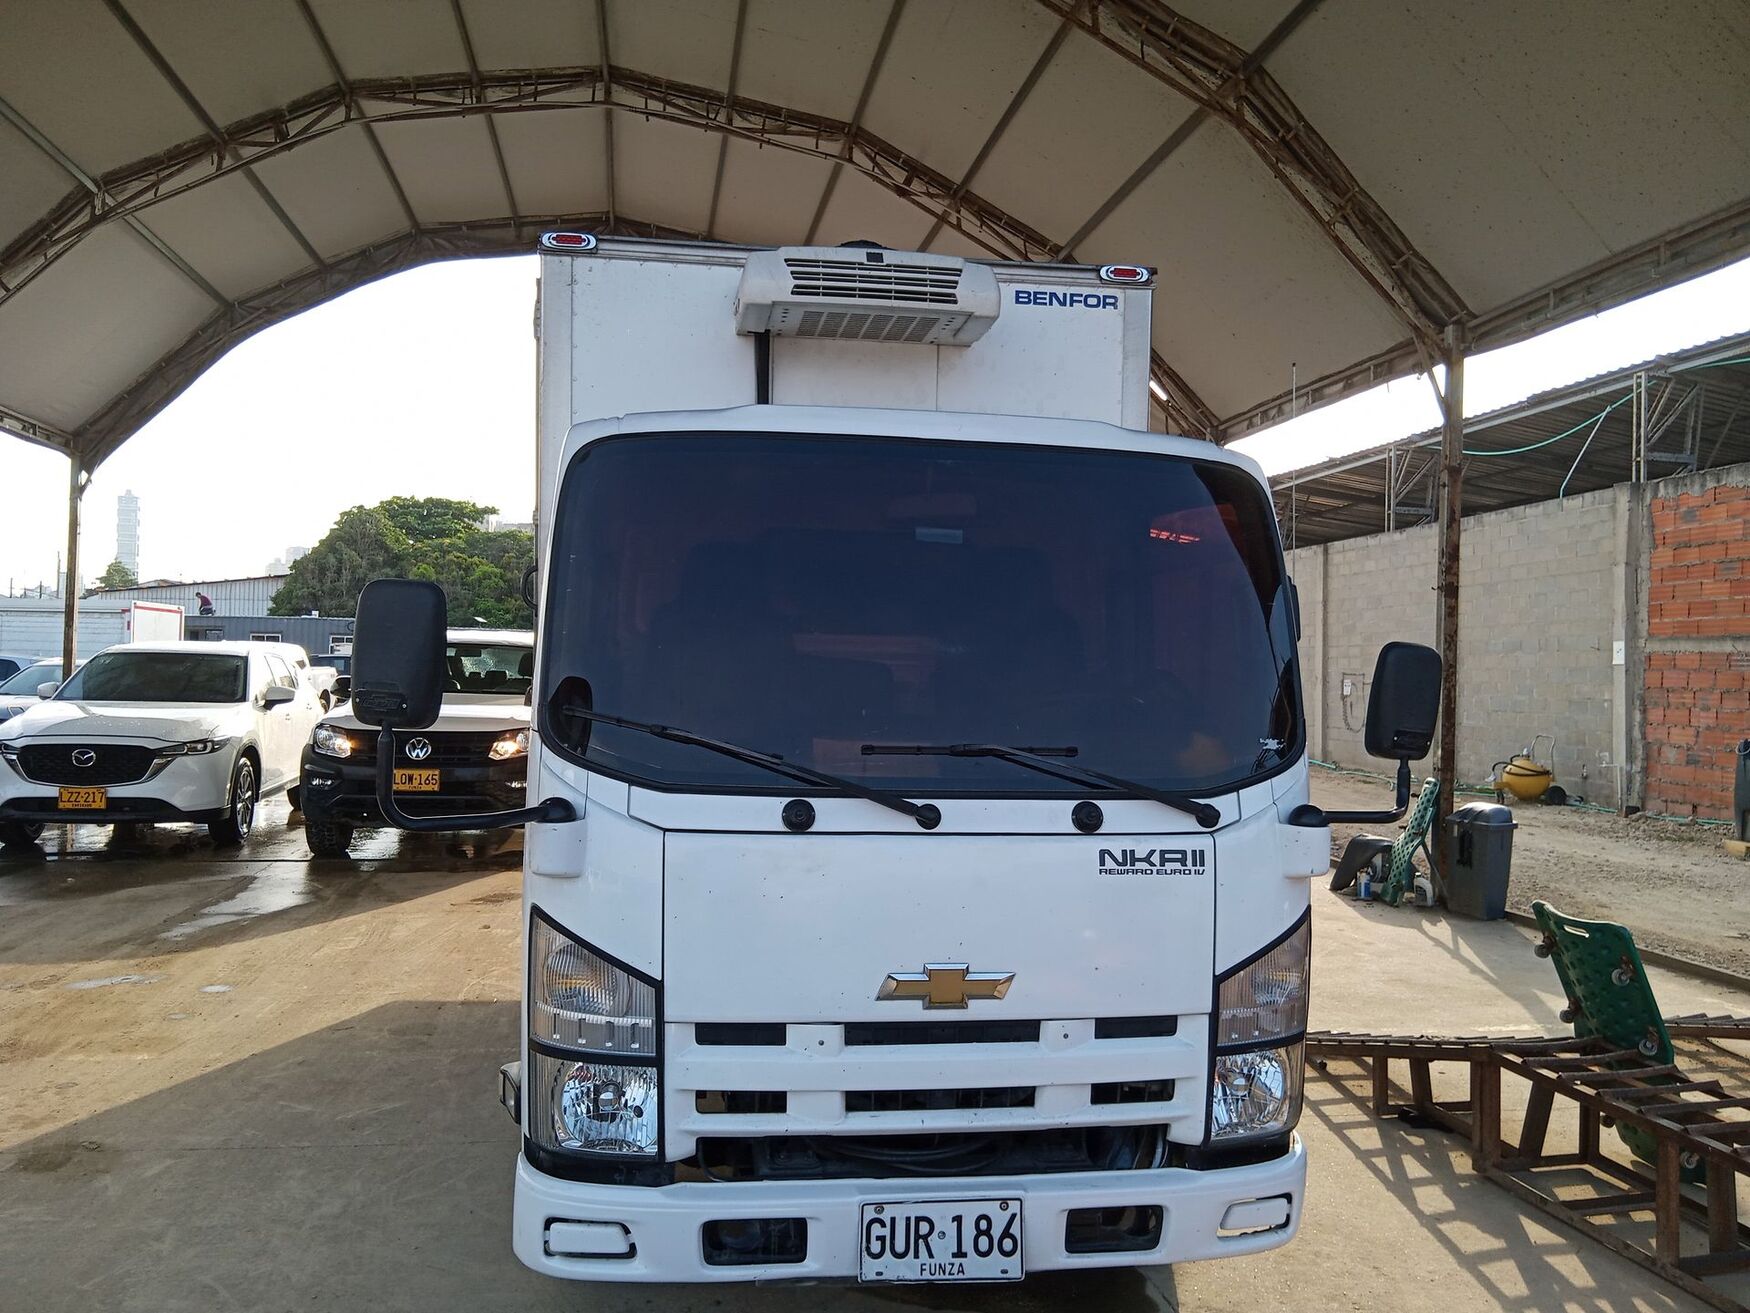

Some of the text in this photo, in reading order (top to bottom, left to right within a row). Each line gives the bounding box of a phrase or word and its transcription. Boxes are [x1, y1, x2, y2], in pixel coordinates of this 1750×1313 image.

[1014, 289, 1119, 310] BENFOR
[1098, 868, 1206, 876] REWARD EURO IV
[919, 1262, 966, 1277] FUNZA
